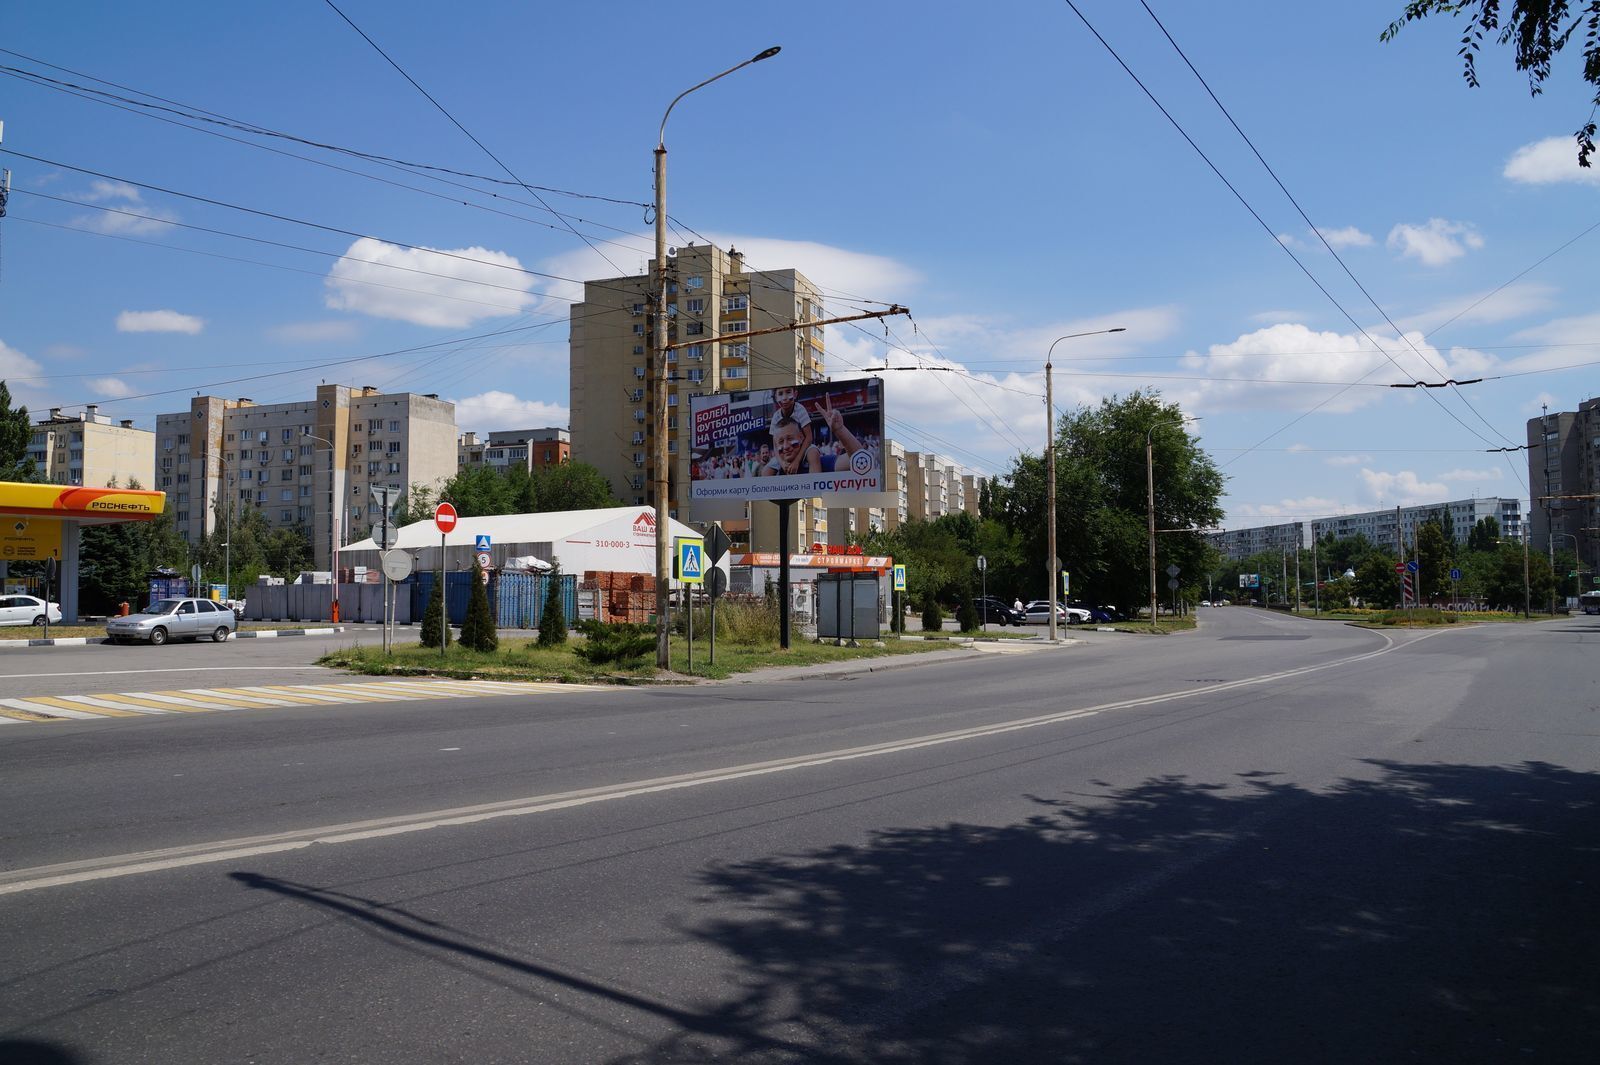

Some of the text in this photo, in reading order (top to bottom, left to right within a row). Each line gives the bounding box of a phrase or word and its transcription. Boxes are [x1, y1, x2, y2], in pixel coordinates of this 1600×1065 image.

[696, 405, 727, 423] БОЛЕЙ
[697, 417, 764, 444] НА СТАДИОНЕ!
[696, 487, 728, 497] Оформи
[729, 486, 750, 496] карту
[751, 484, 799, 493] болельщика
[813, 478, 877, 492] госуслуги
[92, 502, 150, 511] РОСНЕФТЬ
[481, 556, 487, 564] 5
